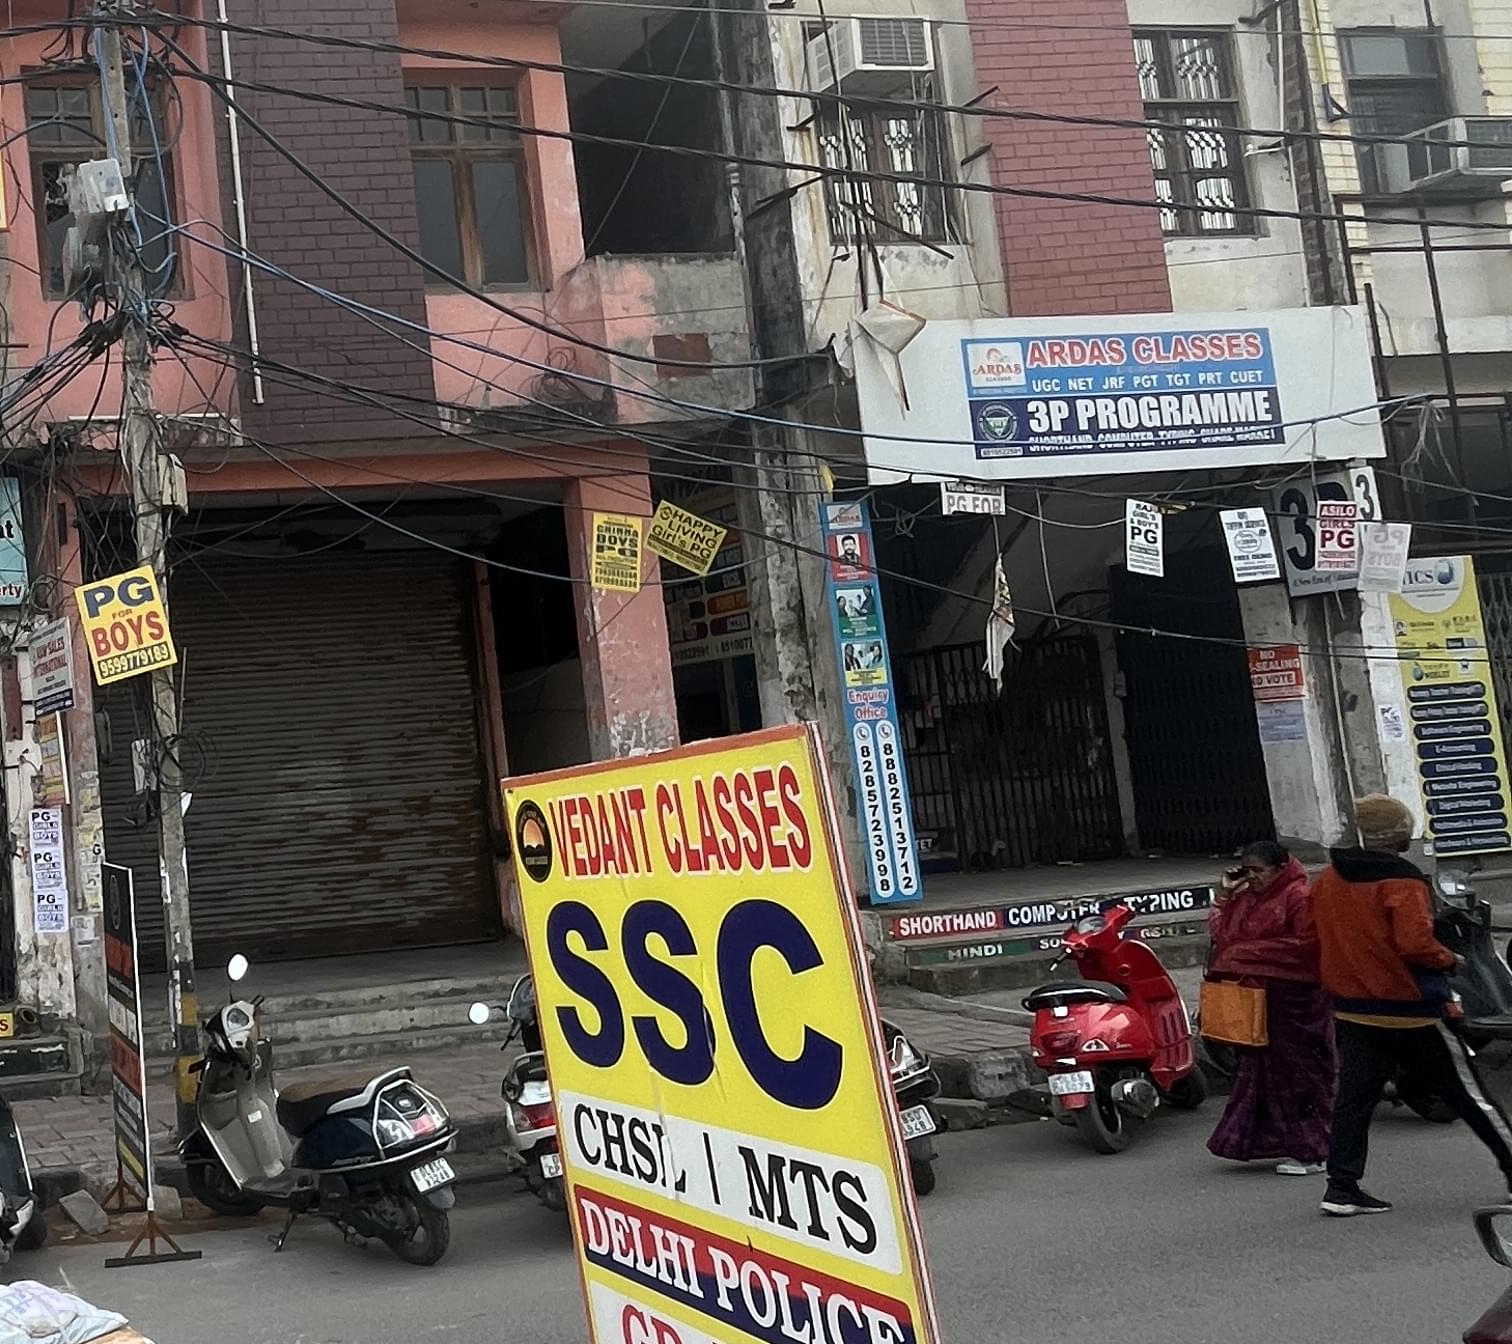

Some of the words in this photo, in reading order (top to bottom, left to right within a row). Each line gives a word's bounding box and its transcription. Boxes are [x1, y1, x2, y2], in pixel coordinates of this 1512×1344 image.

[1026, 340, 1126, 368] ARDAS
[1133, 333, 1263, 365] CLASSES
[1032, 379, 1061, 393] UGC
[1068, 378, 1094, 392] NET
[1102, 377, 1125, 390] JRF
[1134, 376, 1158, 388] PGT
[1166, 374, 1190, 387] TGT
[1199, 373, 1222, 385] PRT
[1231, 371, 1263, 385] CUET
[1027, 400, 1069, 433] 3P
[1075, 391, 1273, 431] PROGRAMME
[946, 493, 969, 514] PG
[972, 492, 1002, 514] FOR
[1319, 504, 1356, 518] ASILO
[667, 520, 718, 549] LIVING
[672, 508, 724, 539] HAPPY
[1130, 526, 1158, 545] PG
[1319, 519, 1356, 529] GIRLS
[596, 533, 639, 548] BOYS
[651, 523, 687, 549] Girl's
[689, 540, 712, 561] PG
[1319, 529, 1355, 551] PG
[83, 576, 155, 619] PG
[111, 608, 133, 620] FOR
[91, 610, 165, 657] BOYS
[99, 643, 170, 678] 9599779189
[1266, 673, 1294, 685] VOTE
[847, 687, 889, 705] Enquiry
[853, 704, 888, 722] Office
[547, 786, 654, 879] VEDANT
[655, 762, 814, 875] CLASSES
[898, 910, 997, 937] SHORTHAND
[546, 898, 844, 1110] SSC
[573, 1101, 687, 1195] CHSL
[738, 1143, 879, 1255] MTS
[581, 1198, 704, 1300] DELHI
